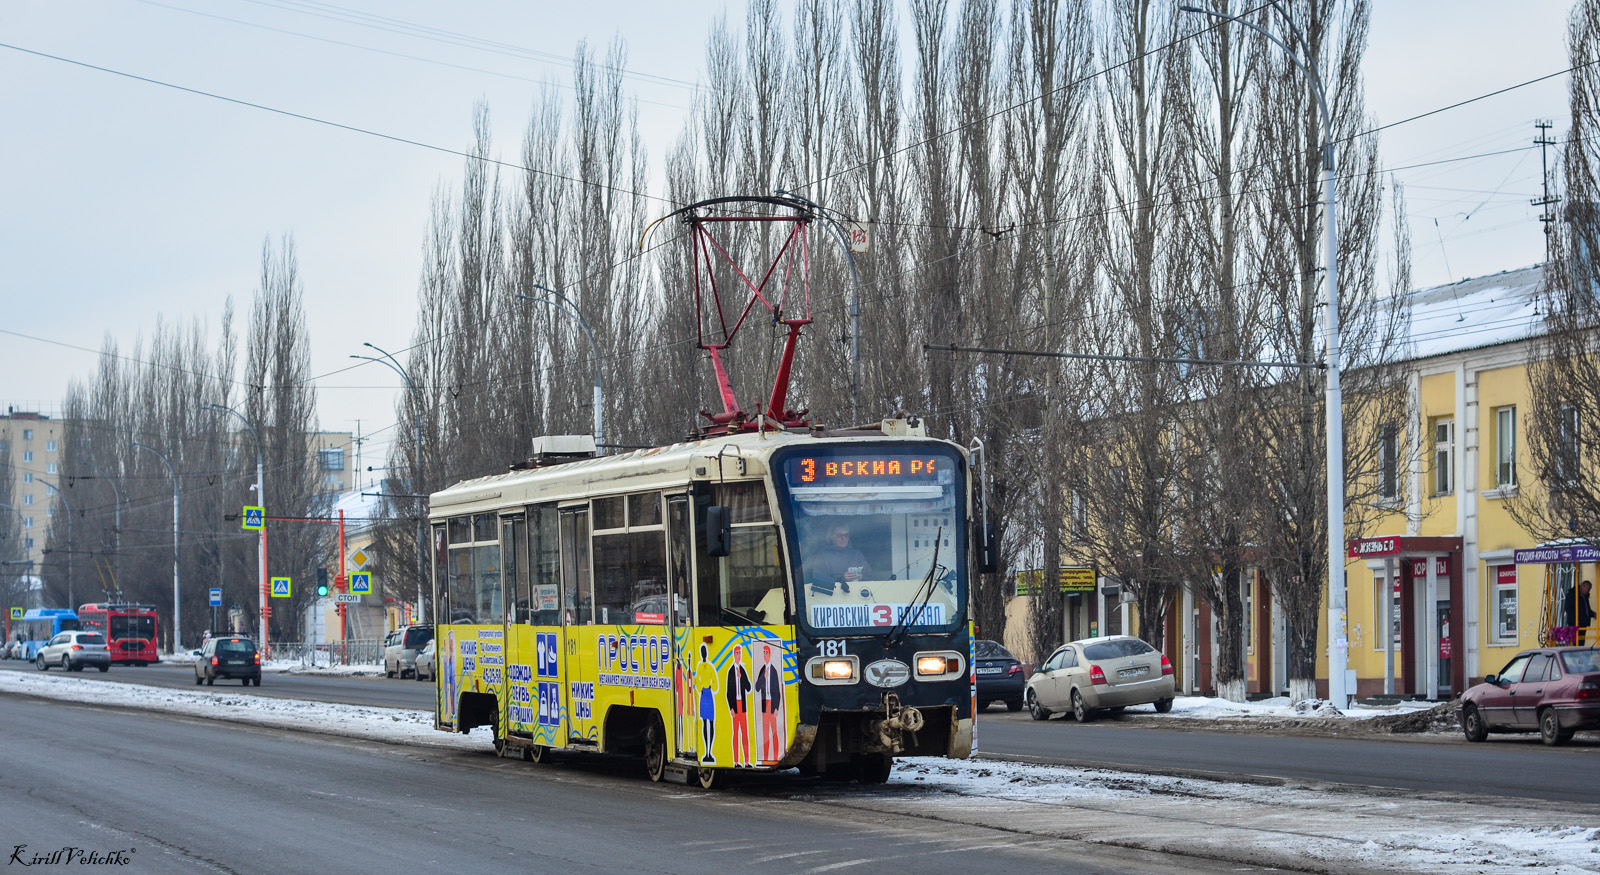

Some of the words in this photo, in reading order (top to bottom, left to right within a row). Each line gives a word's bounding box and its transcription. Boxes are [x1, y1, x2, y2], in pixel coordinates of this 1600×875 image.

[801, 458, 815, 482] 3
[1576, 549, 1600, 558] ПАРИ
[1414, 561, 1447, 575] ЮРТЫ
[813, 604, 870, 627] КИРОВСКИЙ
[873, 605, 892, 627] 3
[897, 606, 940, 626] ВОКЗАЛ
[568, 638, 576, 655] 181
[598, 634, 670, 674] ПРОСТОР
[816, 640, 847, 657] 181
[509, 664, 532, 684] ОДЕЖДА
